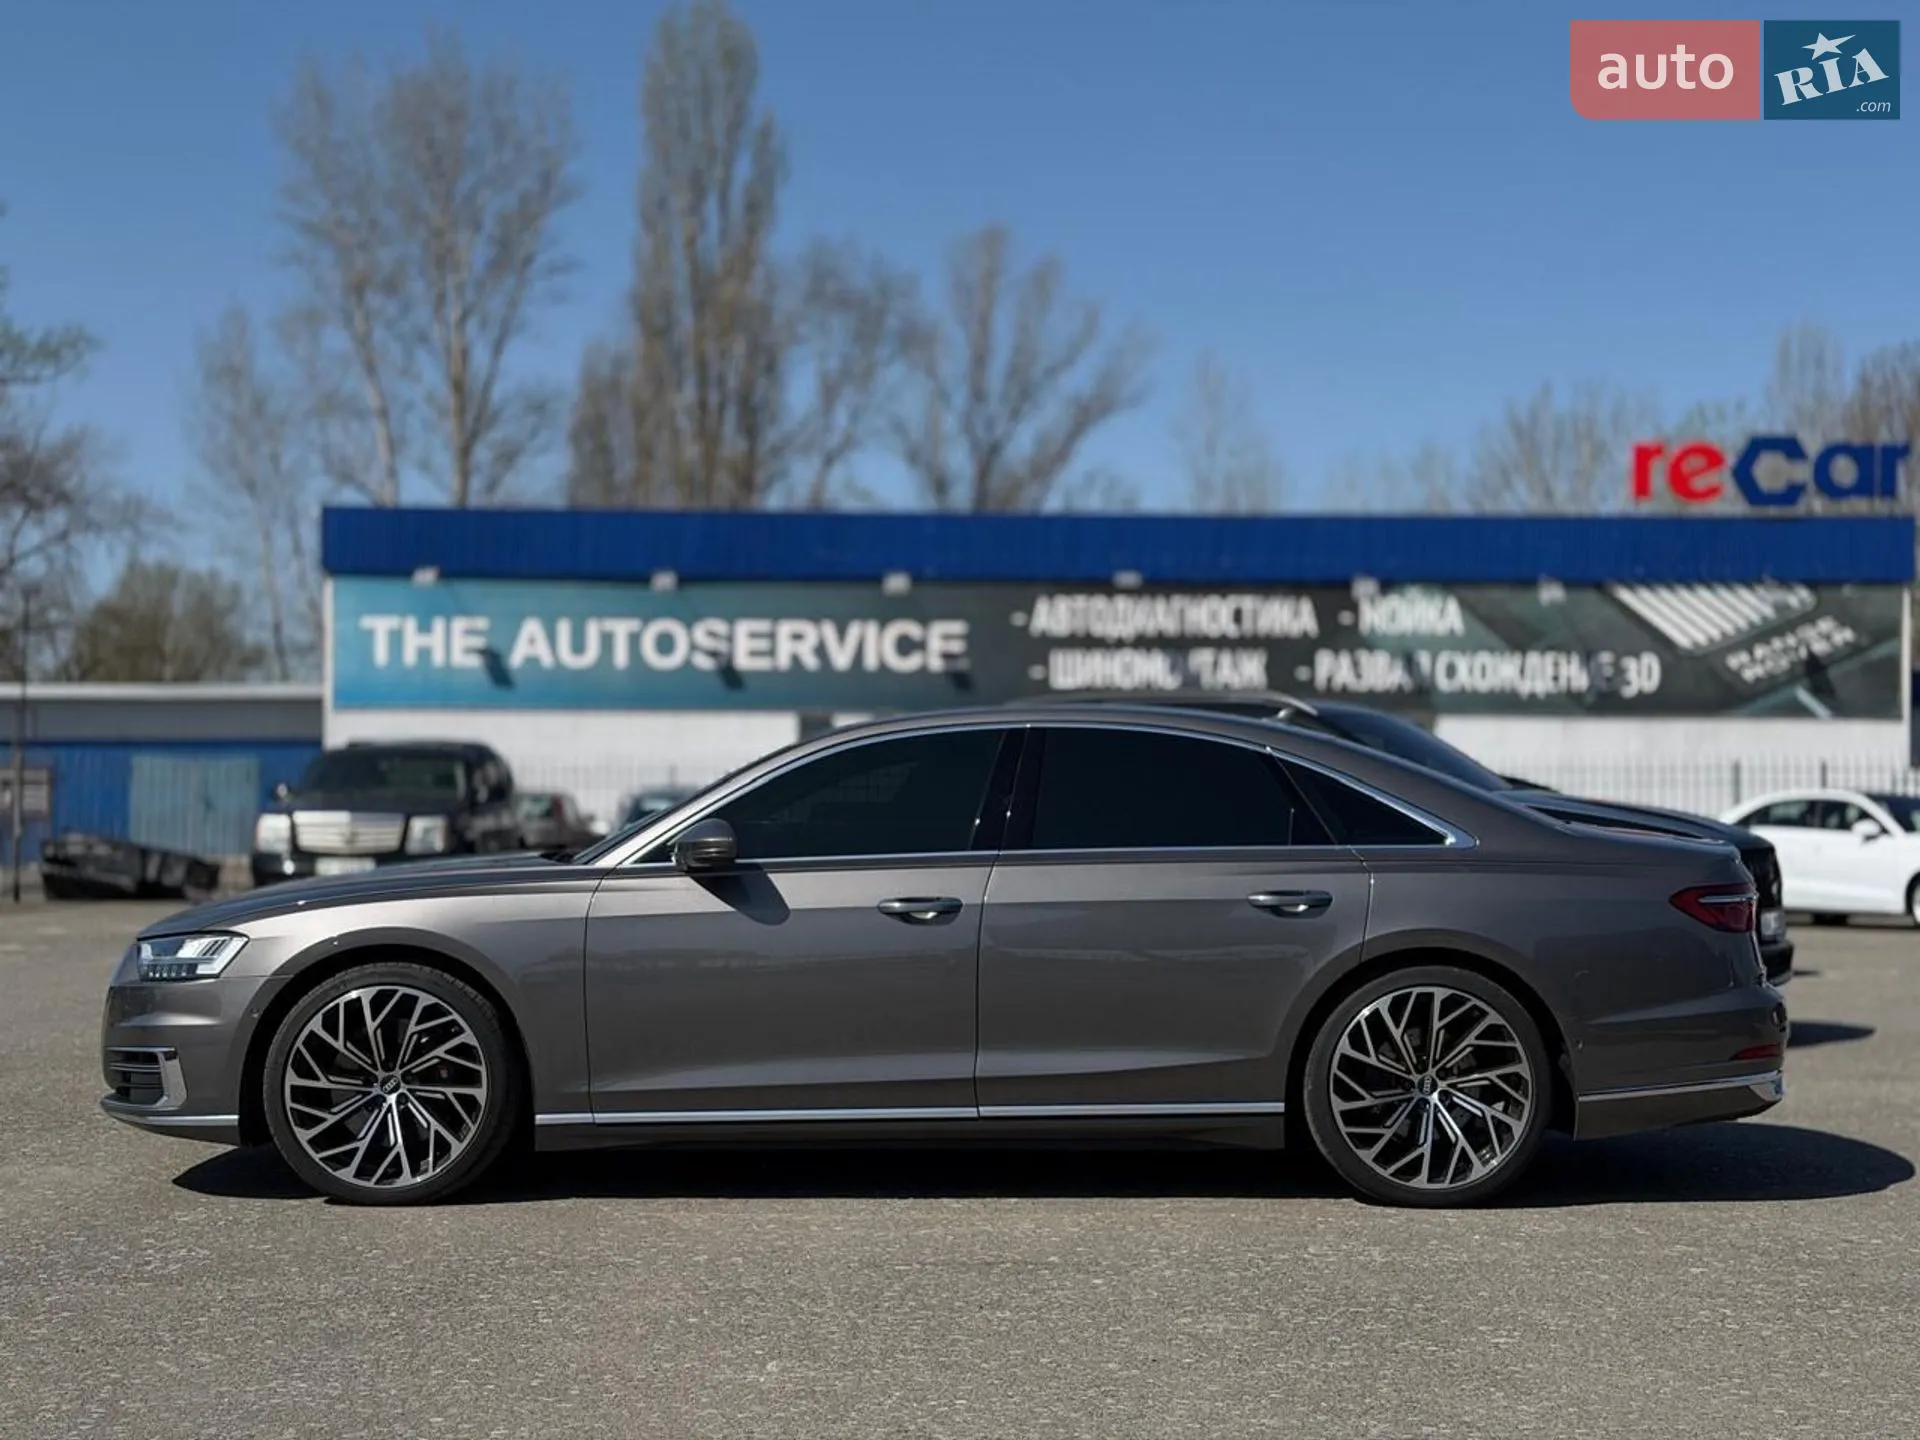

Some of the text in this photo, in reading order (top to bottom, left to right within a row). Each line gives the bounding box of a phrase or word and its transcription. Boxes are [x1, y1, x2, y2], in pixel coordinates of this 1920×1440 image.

[1632, 436, 1909, 505] reCar
[361, 615, 969, 672] THE AUTOSERVICE
